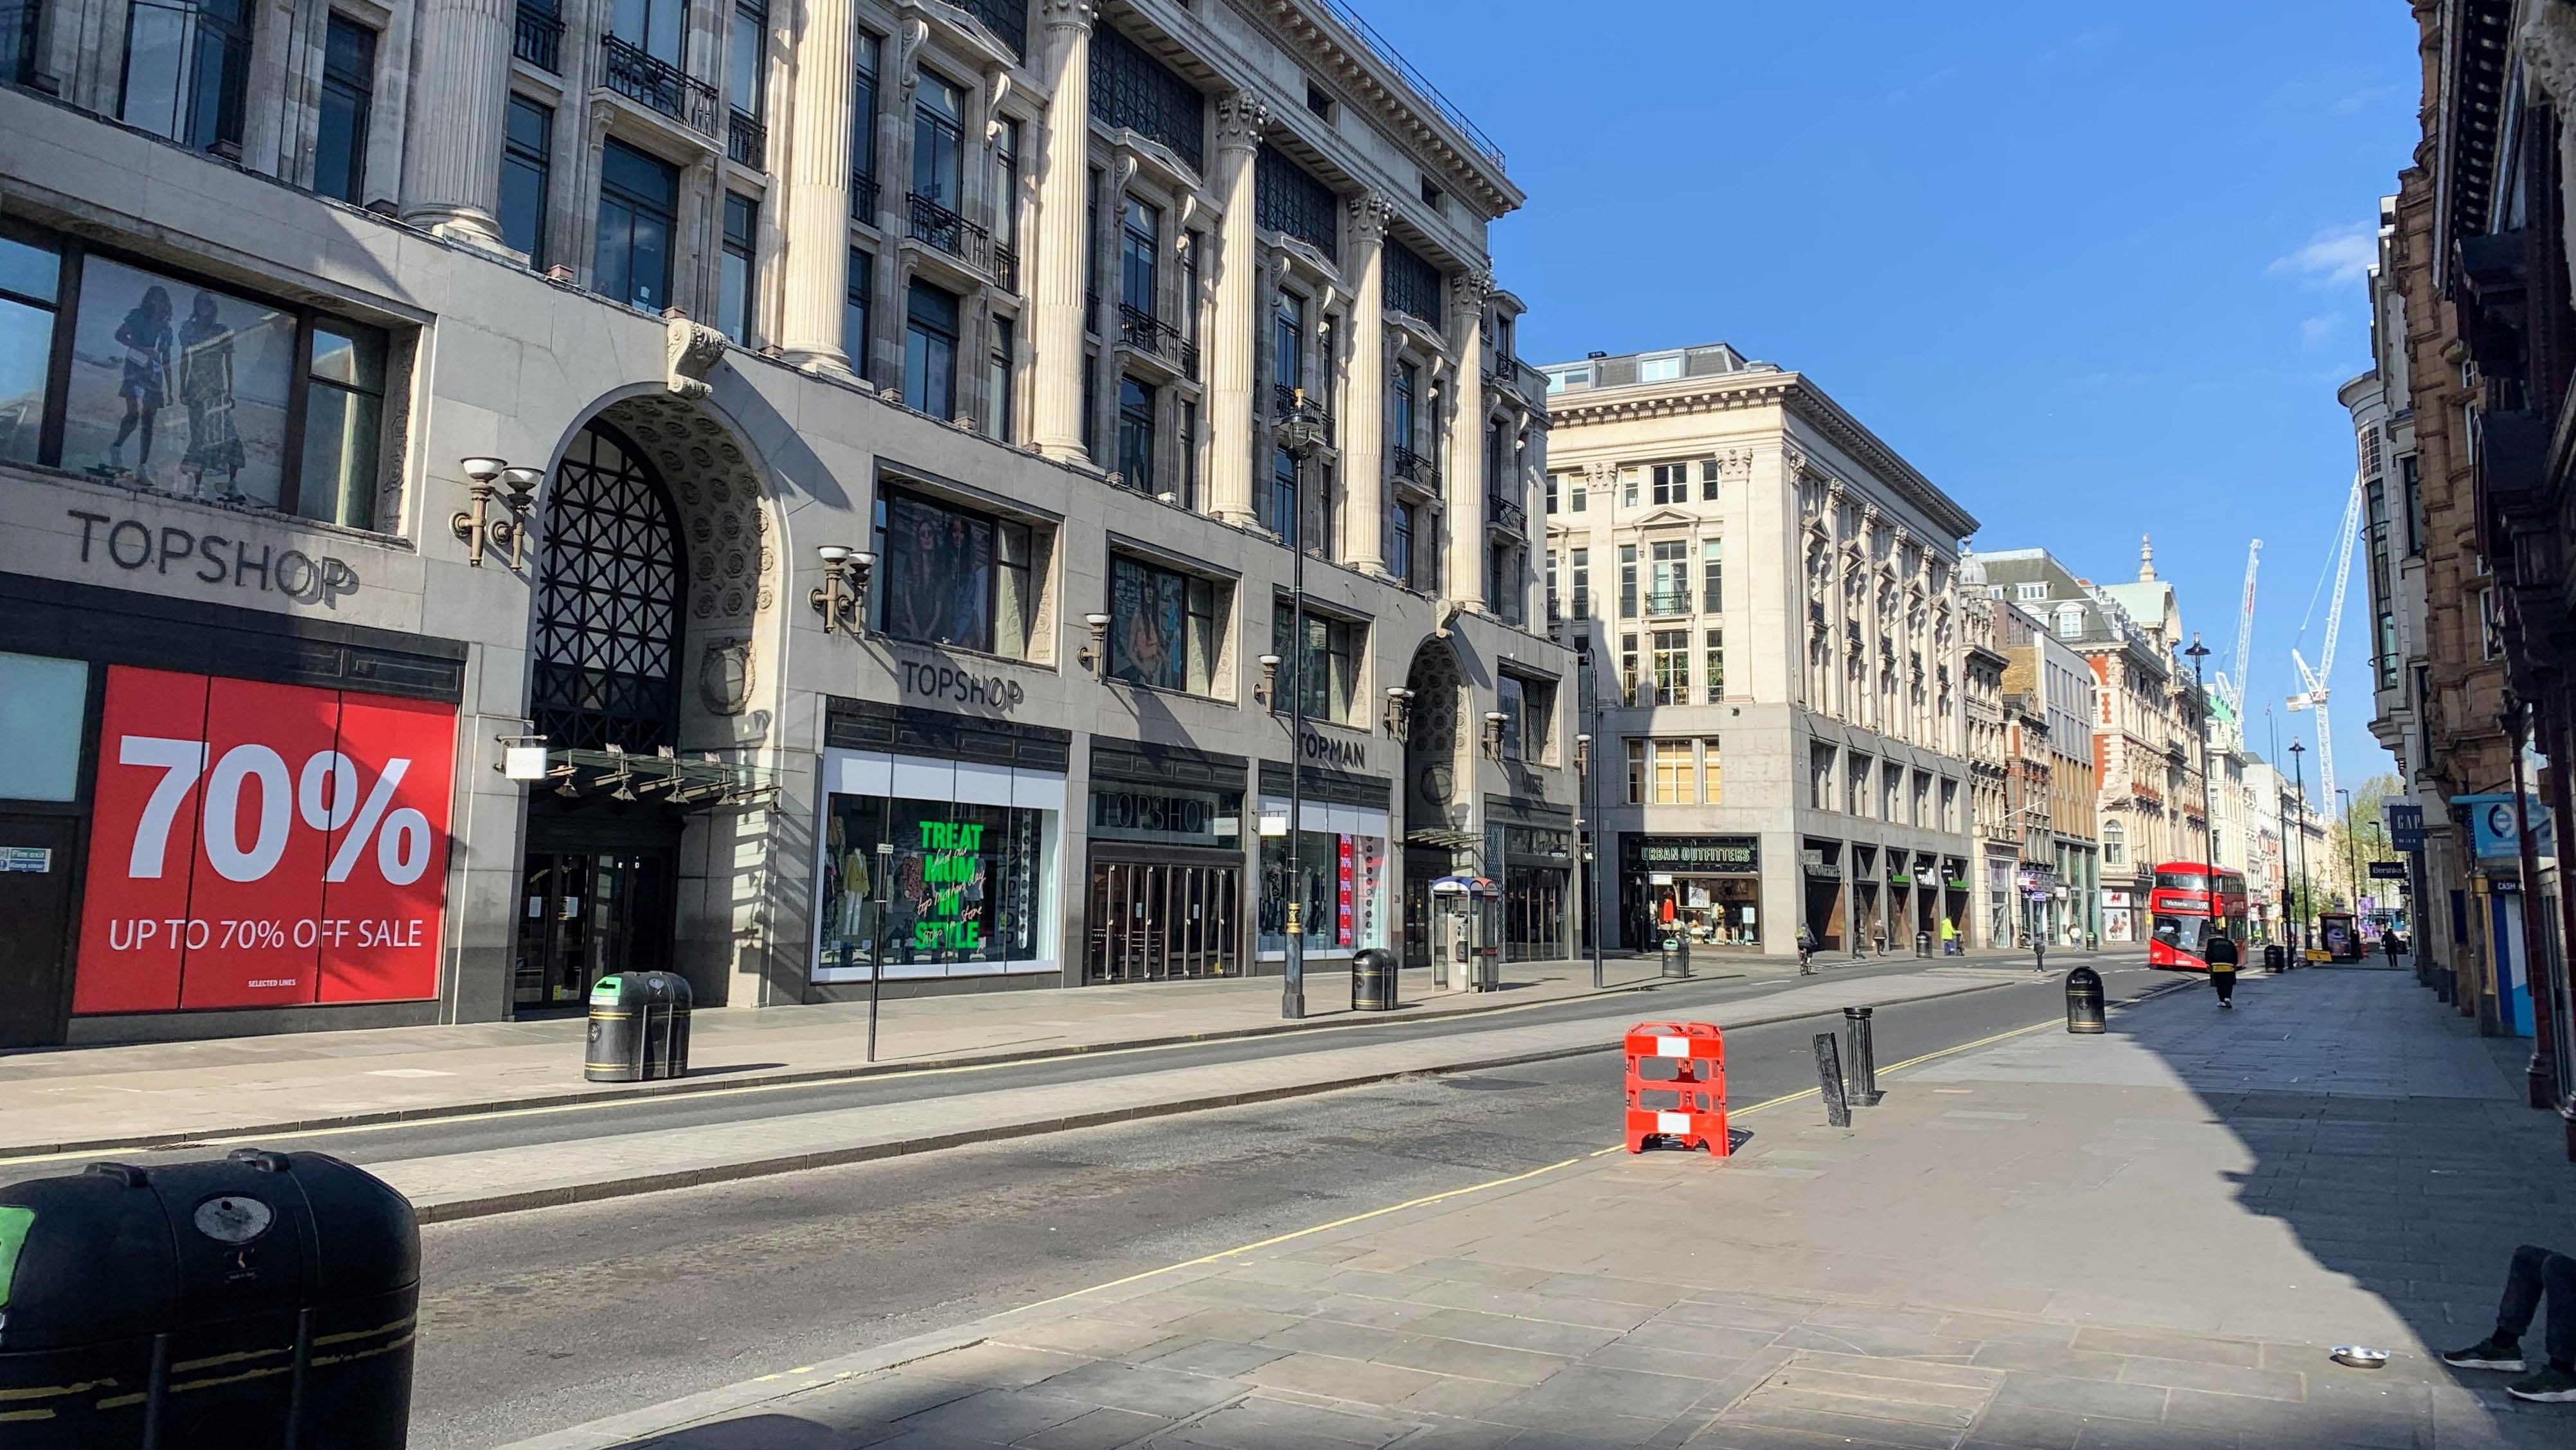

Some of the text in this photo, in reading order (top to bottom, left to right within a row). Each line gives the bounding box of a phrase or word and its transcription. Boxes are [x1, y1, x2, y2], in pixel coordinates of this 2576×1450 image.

[67, 510, 353, 603] TOPSHOP
[901, 659, 1022, 710] TOPSHOP
[119, 735, 431, 886] 70%
[1099, 791, 1215, 832] TOPSHOP
[2397, 814, 2421, 829] GAP
[919, 820, 984, 851] TREAT
[924, 854, 977, 882] MUM
[1641, 846, 1750, 862] URBAN OUTFITTERS
[2497, 882, 2516, 890] CASH
[939, 888, 959, 916] IN
[2197, 901, 2208, 909] 390
[109, 919, 423, 951] UP TO 70% OFF SALE
[914, 921, 980, 950] STYLE
[248, 980, 278, 988] SELECTED
